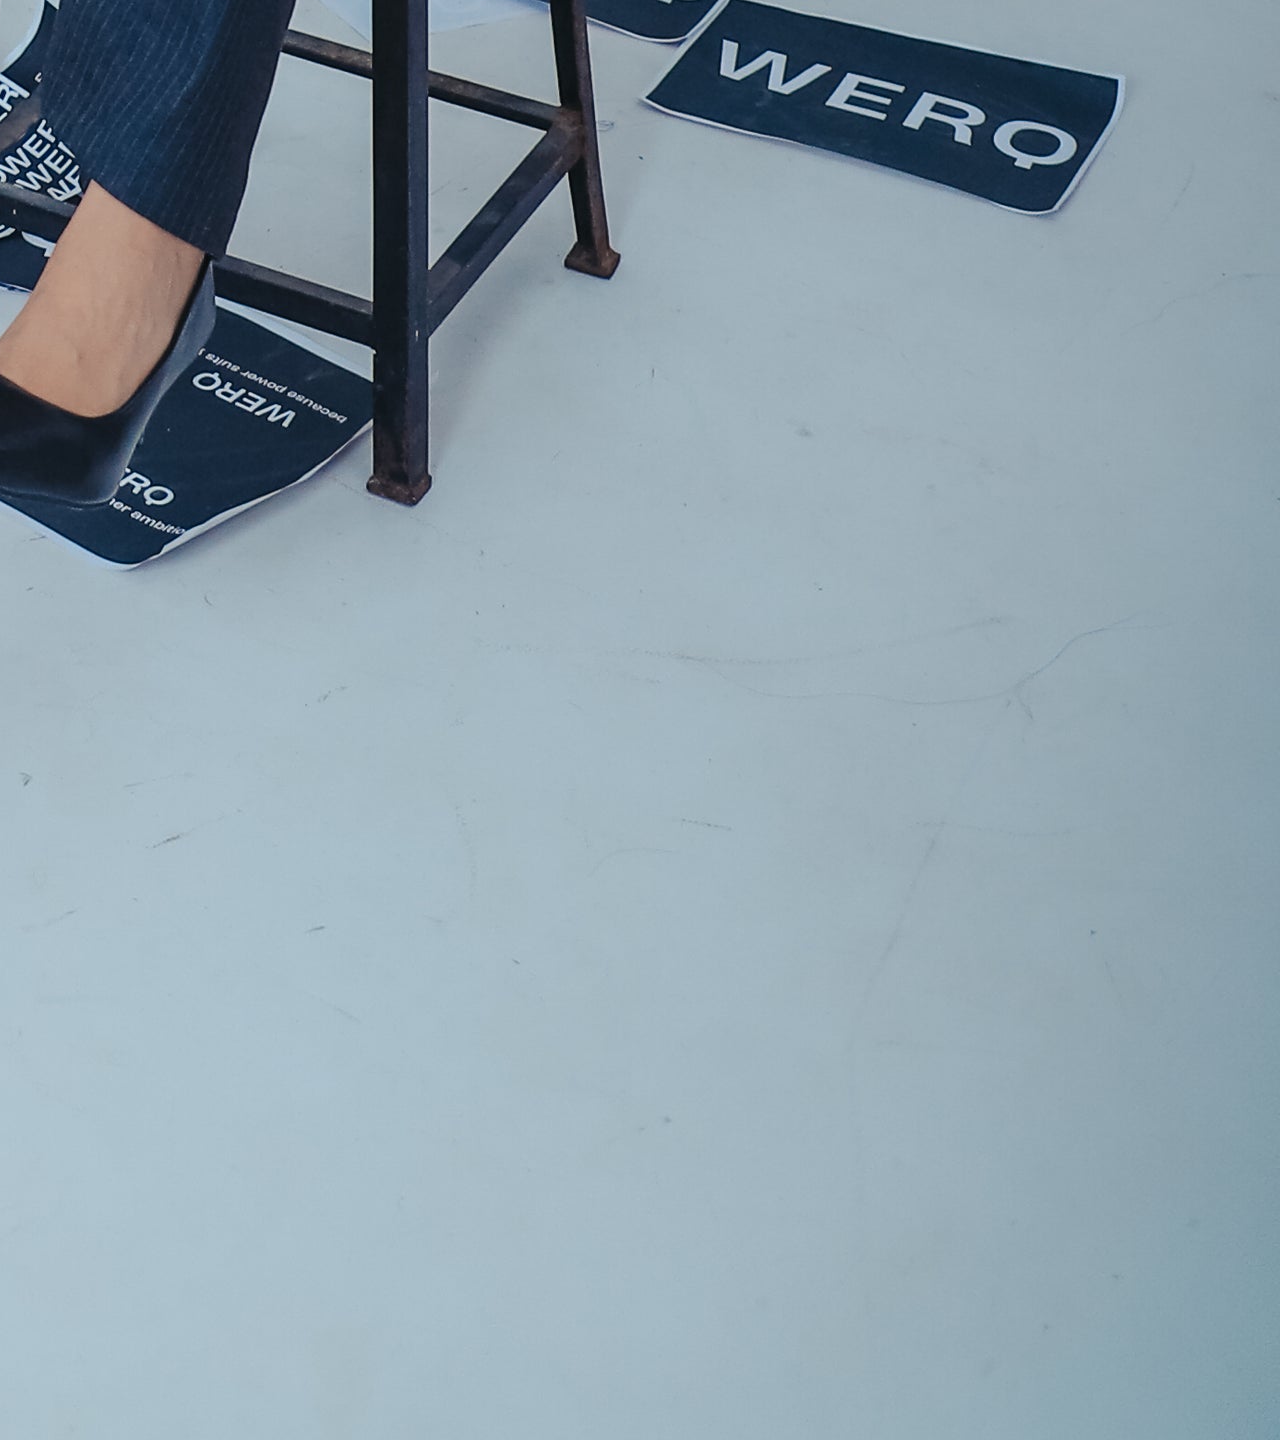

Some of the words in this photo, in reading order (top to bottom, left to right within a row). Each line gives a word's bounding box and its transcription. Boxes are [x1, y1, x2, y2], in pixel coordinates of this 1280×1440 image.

[720, 39, 1077, 170] WERQ
[204, 352, 240, 373] suits
[192, 371, 297, 428] WERQ
[240, 370, 288, 394] power
[287, 390, 349, 425] because
[119, 468, 175, 506] RQ
[130, 509, 188, 537] ambitio
